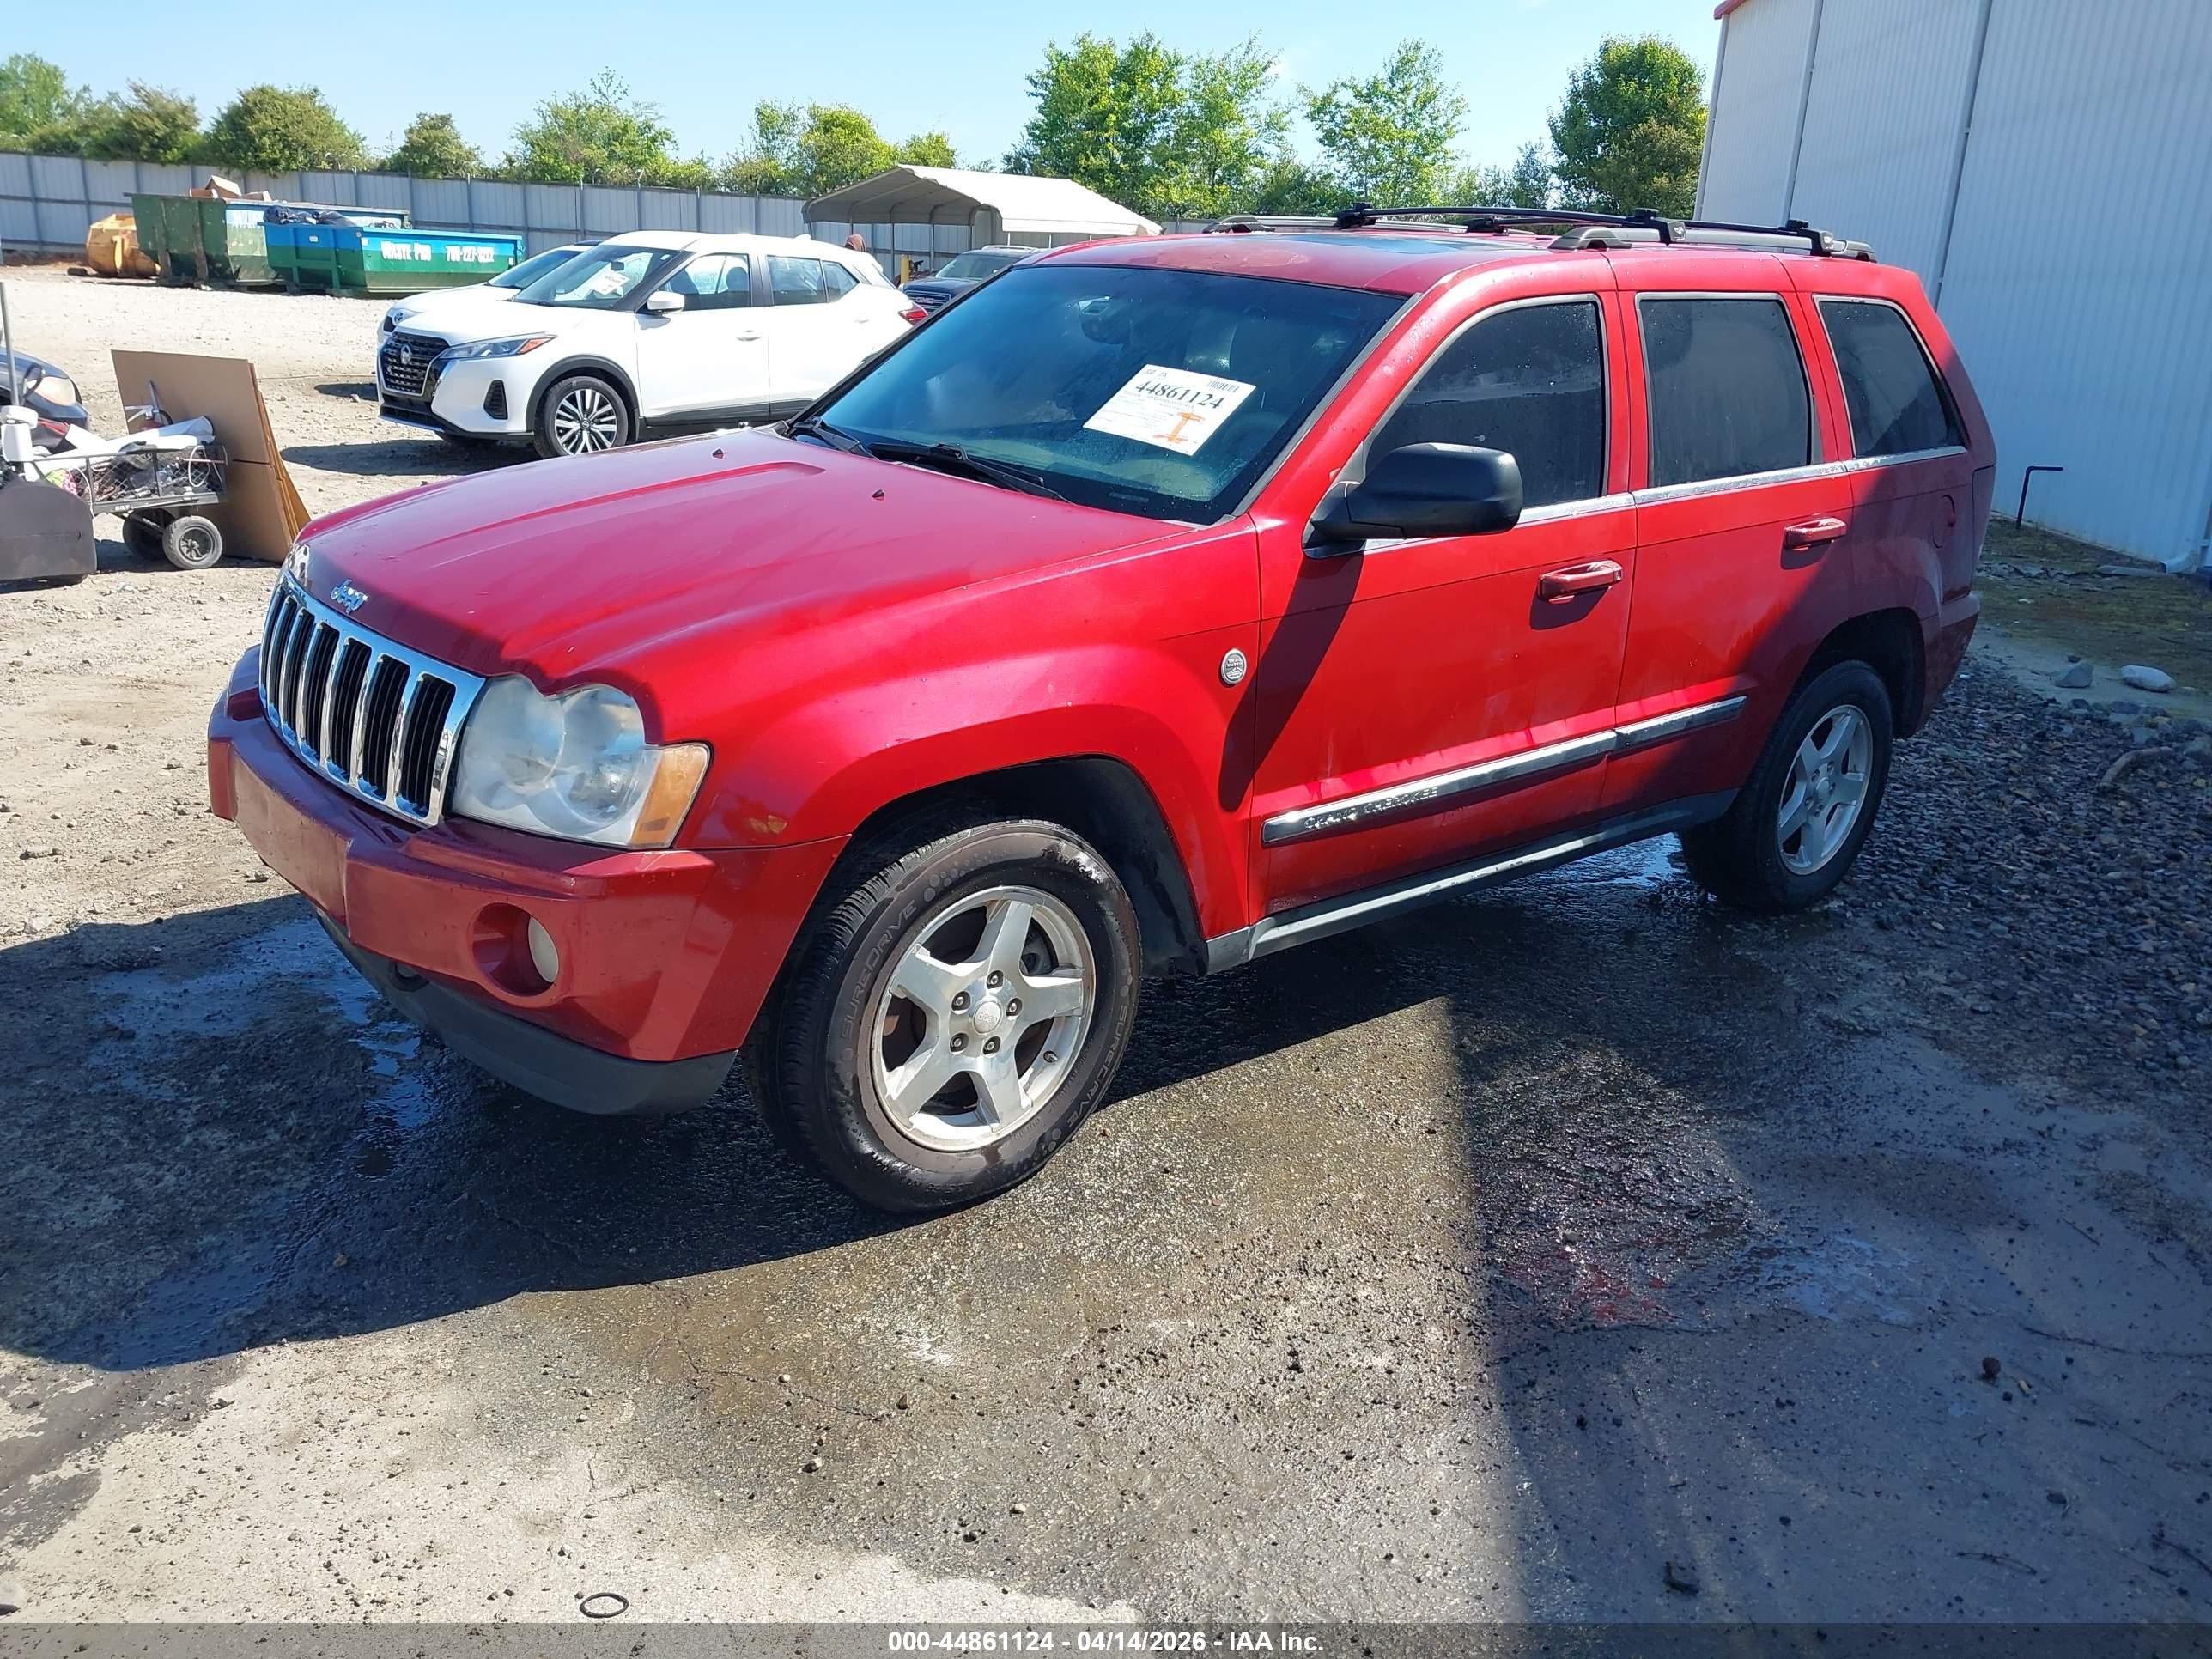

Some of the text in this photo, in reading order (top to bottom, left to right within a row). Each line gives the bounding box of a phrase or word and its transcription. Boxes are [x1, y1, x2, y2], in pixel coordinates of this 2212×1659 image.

[1135, 380, 1226, 409] 44861124
[331, 578, 369, 615] Jeep
[1304, 787, 1438, 829] GRAND CHEROKEE
[841, 900, 917, 1039] SUREDRIVE
[1066, 1005, 1128, 1128] SUREDRIVE
